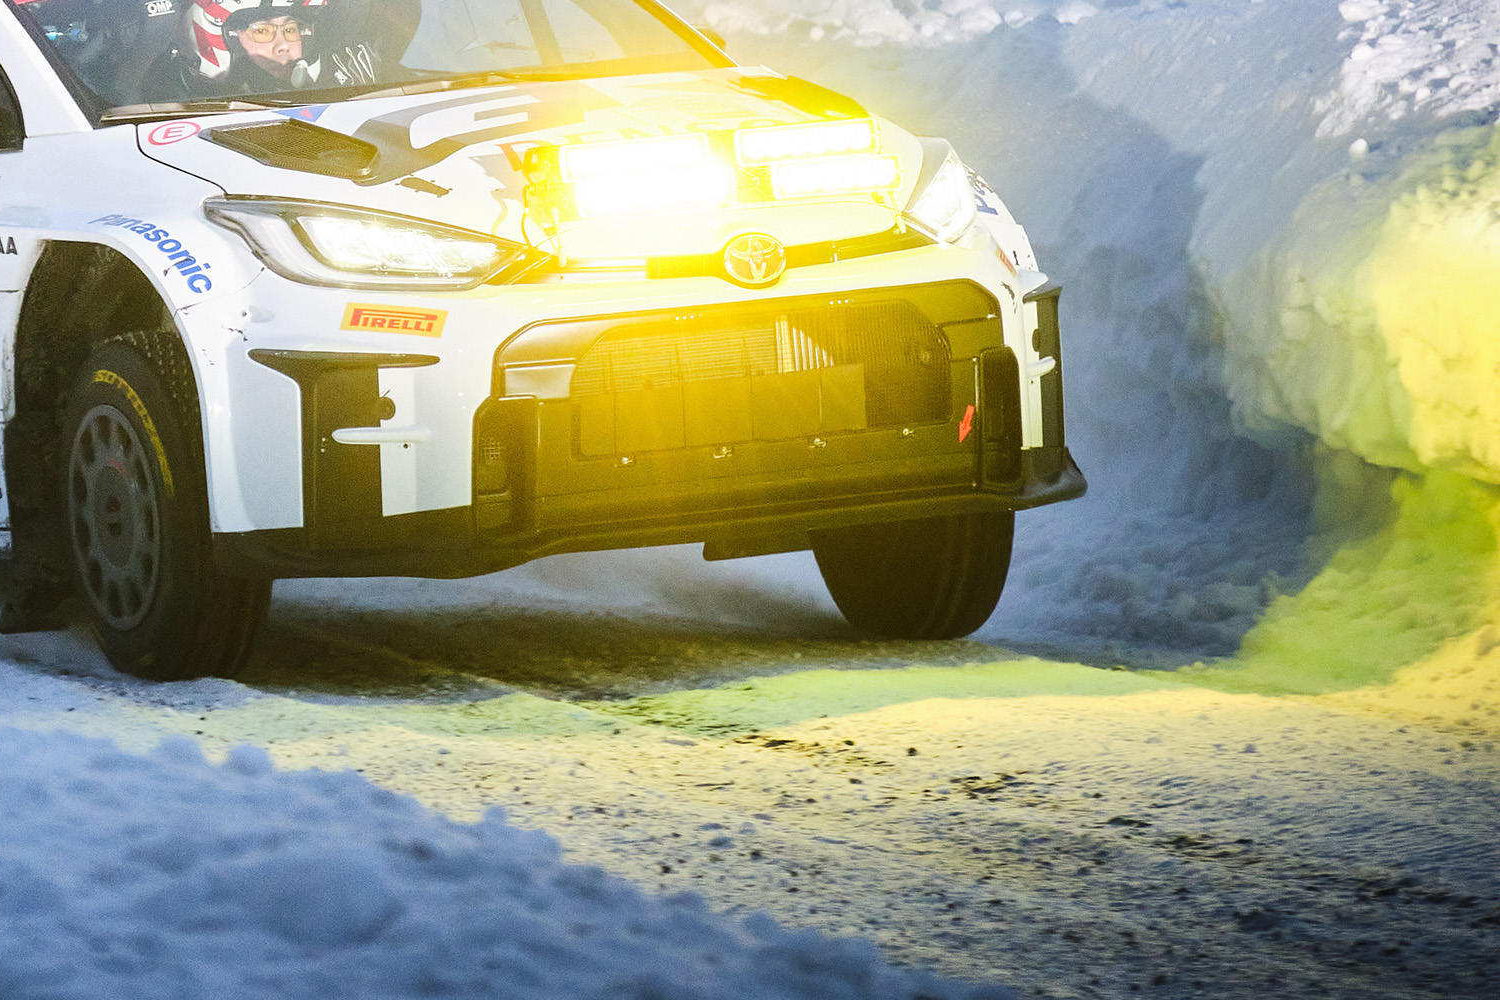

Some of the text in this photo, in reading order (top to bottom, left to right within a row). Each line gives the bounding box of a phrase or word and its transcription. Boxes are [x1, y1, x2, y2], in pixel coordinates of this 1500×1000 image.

[147, 0, 173, 15] OMP
[162, 126, 186, 140] E
[87, 213, 213, 294] Panasonic
[349, 308, 438, 333] PIRELLI
